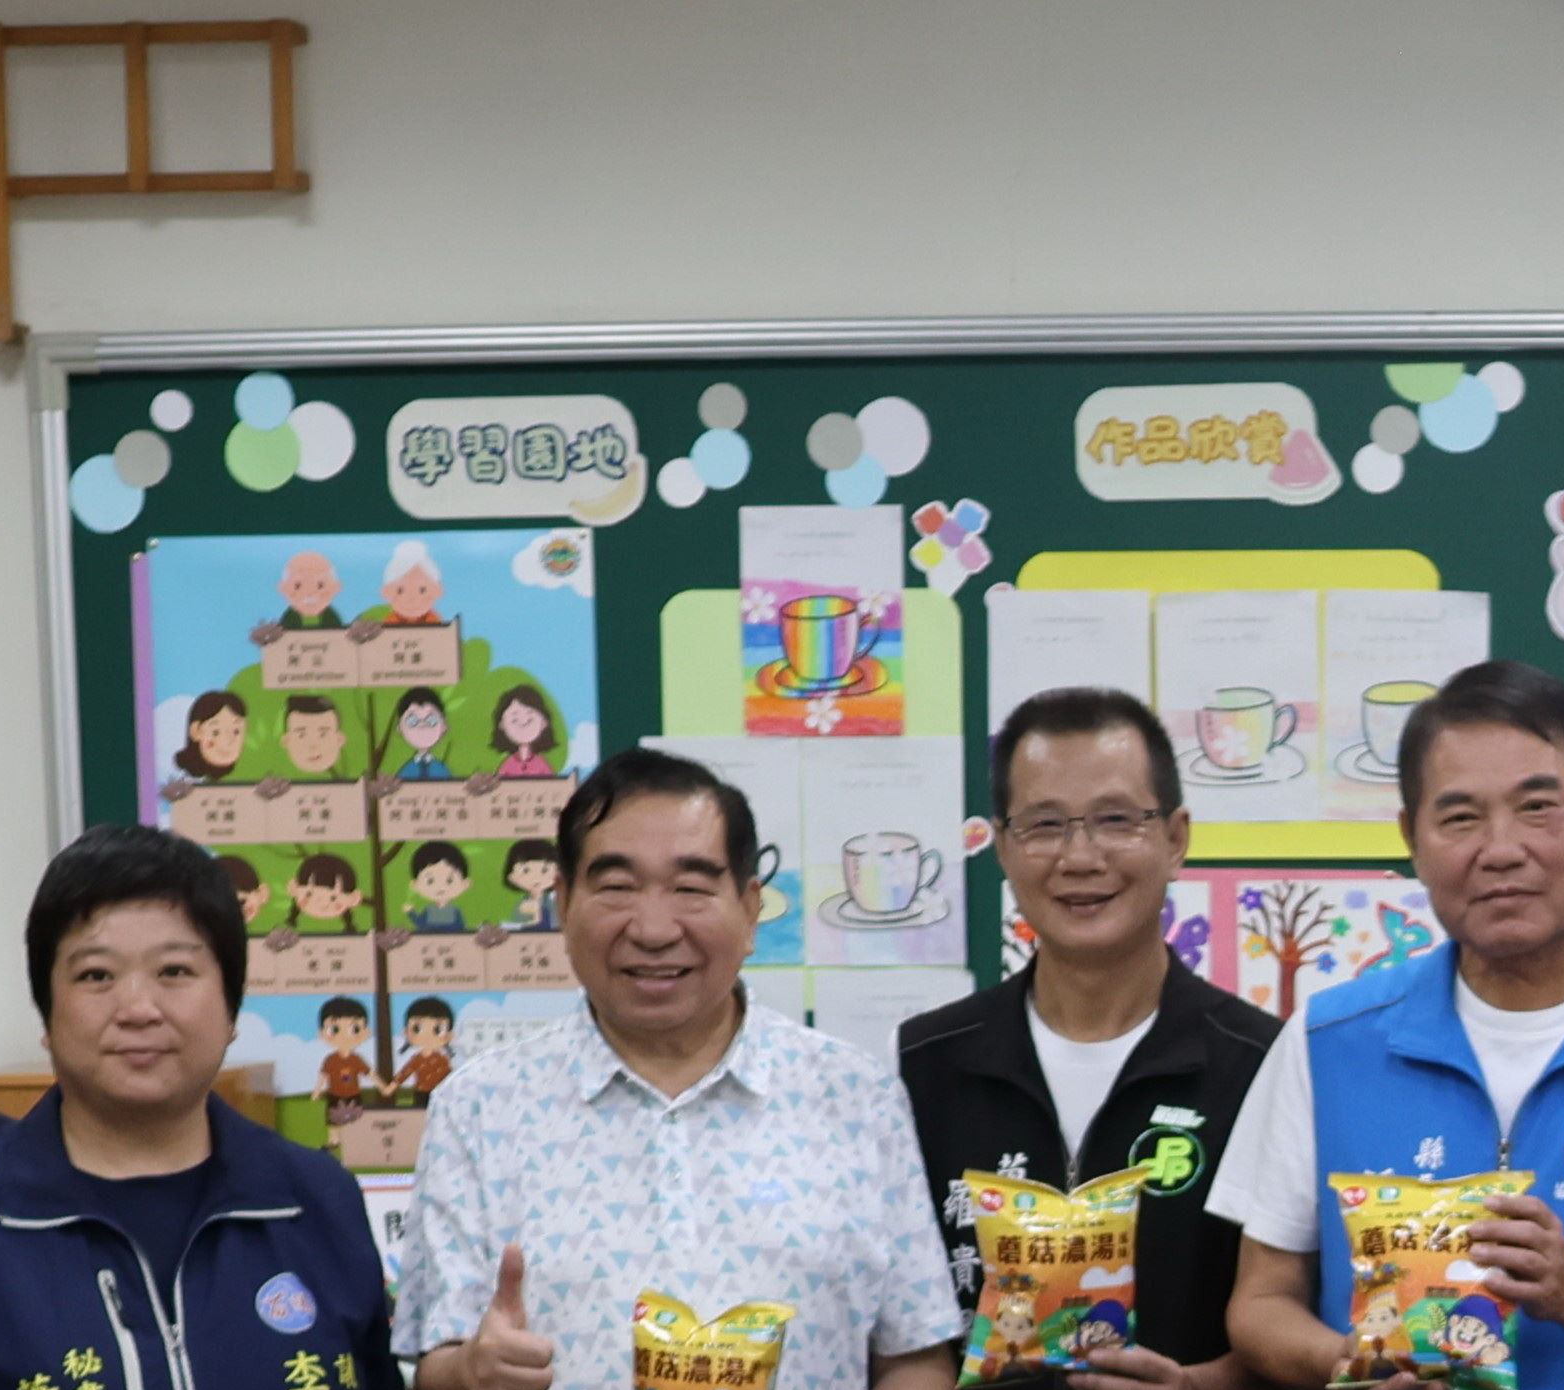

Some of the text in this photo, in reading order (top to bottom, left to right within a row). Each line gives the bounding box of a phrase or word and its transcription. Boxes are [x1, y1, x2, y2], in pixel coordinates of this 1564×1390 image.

[399, 422, 630, 489] 學習園地
[1084, 410, 1289, 467] 作品欣賞
